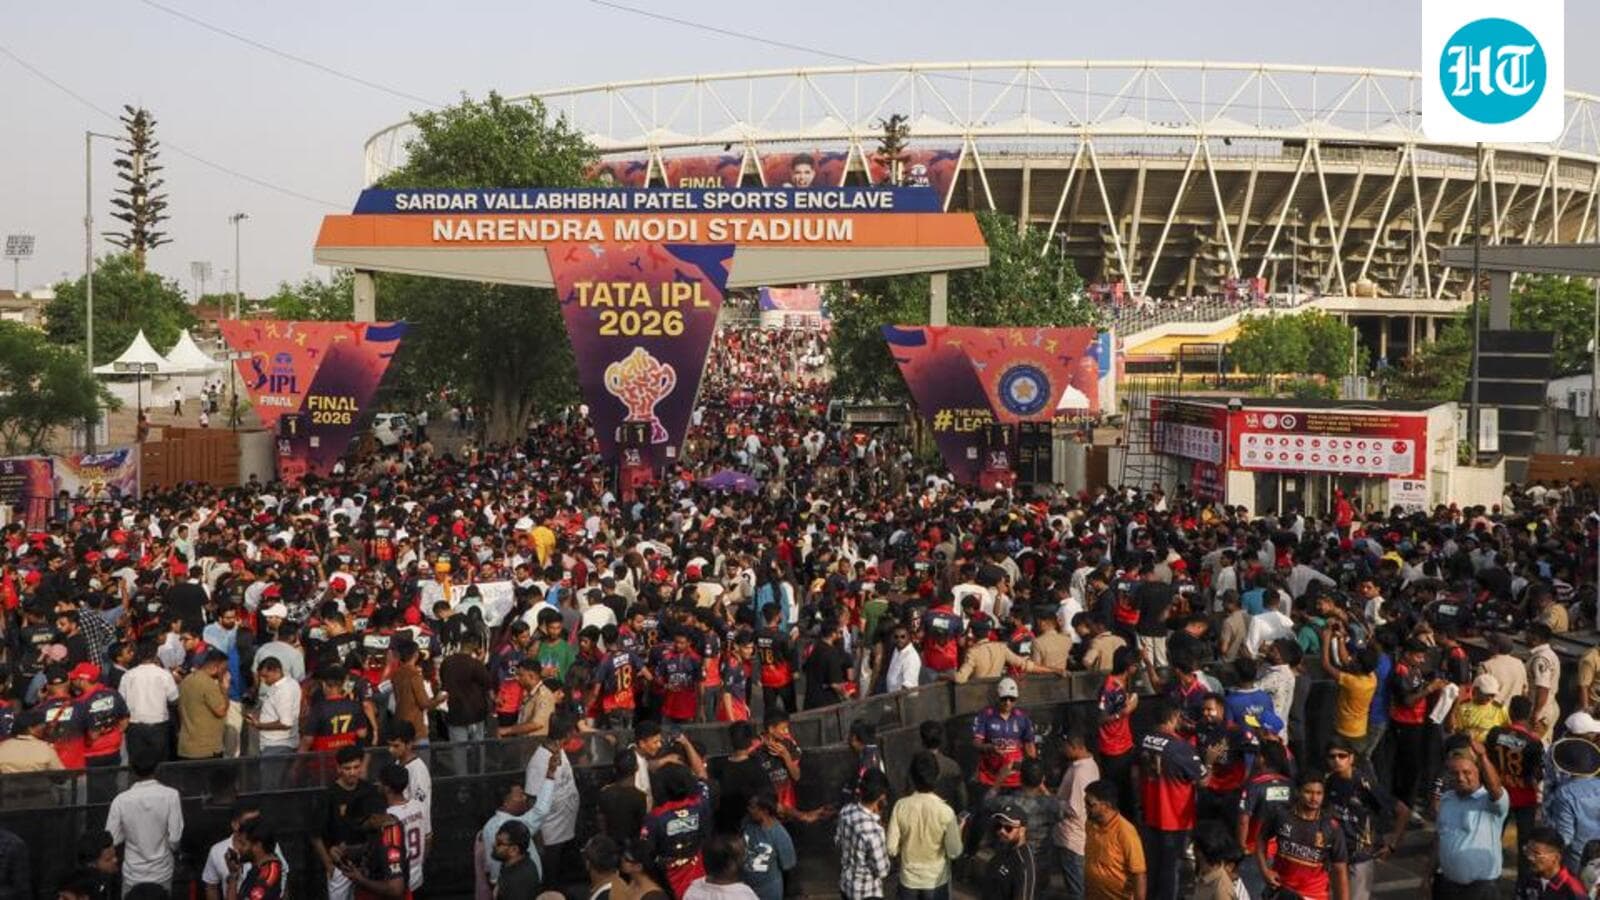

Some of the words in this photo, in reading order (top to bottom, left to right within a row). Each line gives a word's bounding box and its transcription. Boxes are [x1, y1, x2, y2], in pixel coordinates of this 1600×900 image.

[395, 193, 478, 210] SARDAR
[484, 193, 627, 210] VALLABHBHAI
[634, 192, 698, 209] PATEL
[704, 192, 788, 209] SPORTS
[795, 191, 894, 209] ENCLAVE
[433, 219, 605, 242] NARENDRA
[614, 218, 698, 241] MODI
[708, 218, 853, 241] STADIUM
[574, 282, 652, 307] TATA
[661, 282, 710, 307] IPL
[600, 311, 684, 336] 2026
[270, 375, 300, 393] IPL
[260, 396, 293, 407] FINAL
[308, 396, 359, 411] FINAL
[312, 411, 351, 424] 2026
[615, 665, 632, 690] 18
[330, 714, 352, 734] 17
